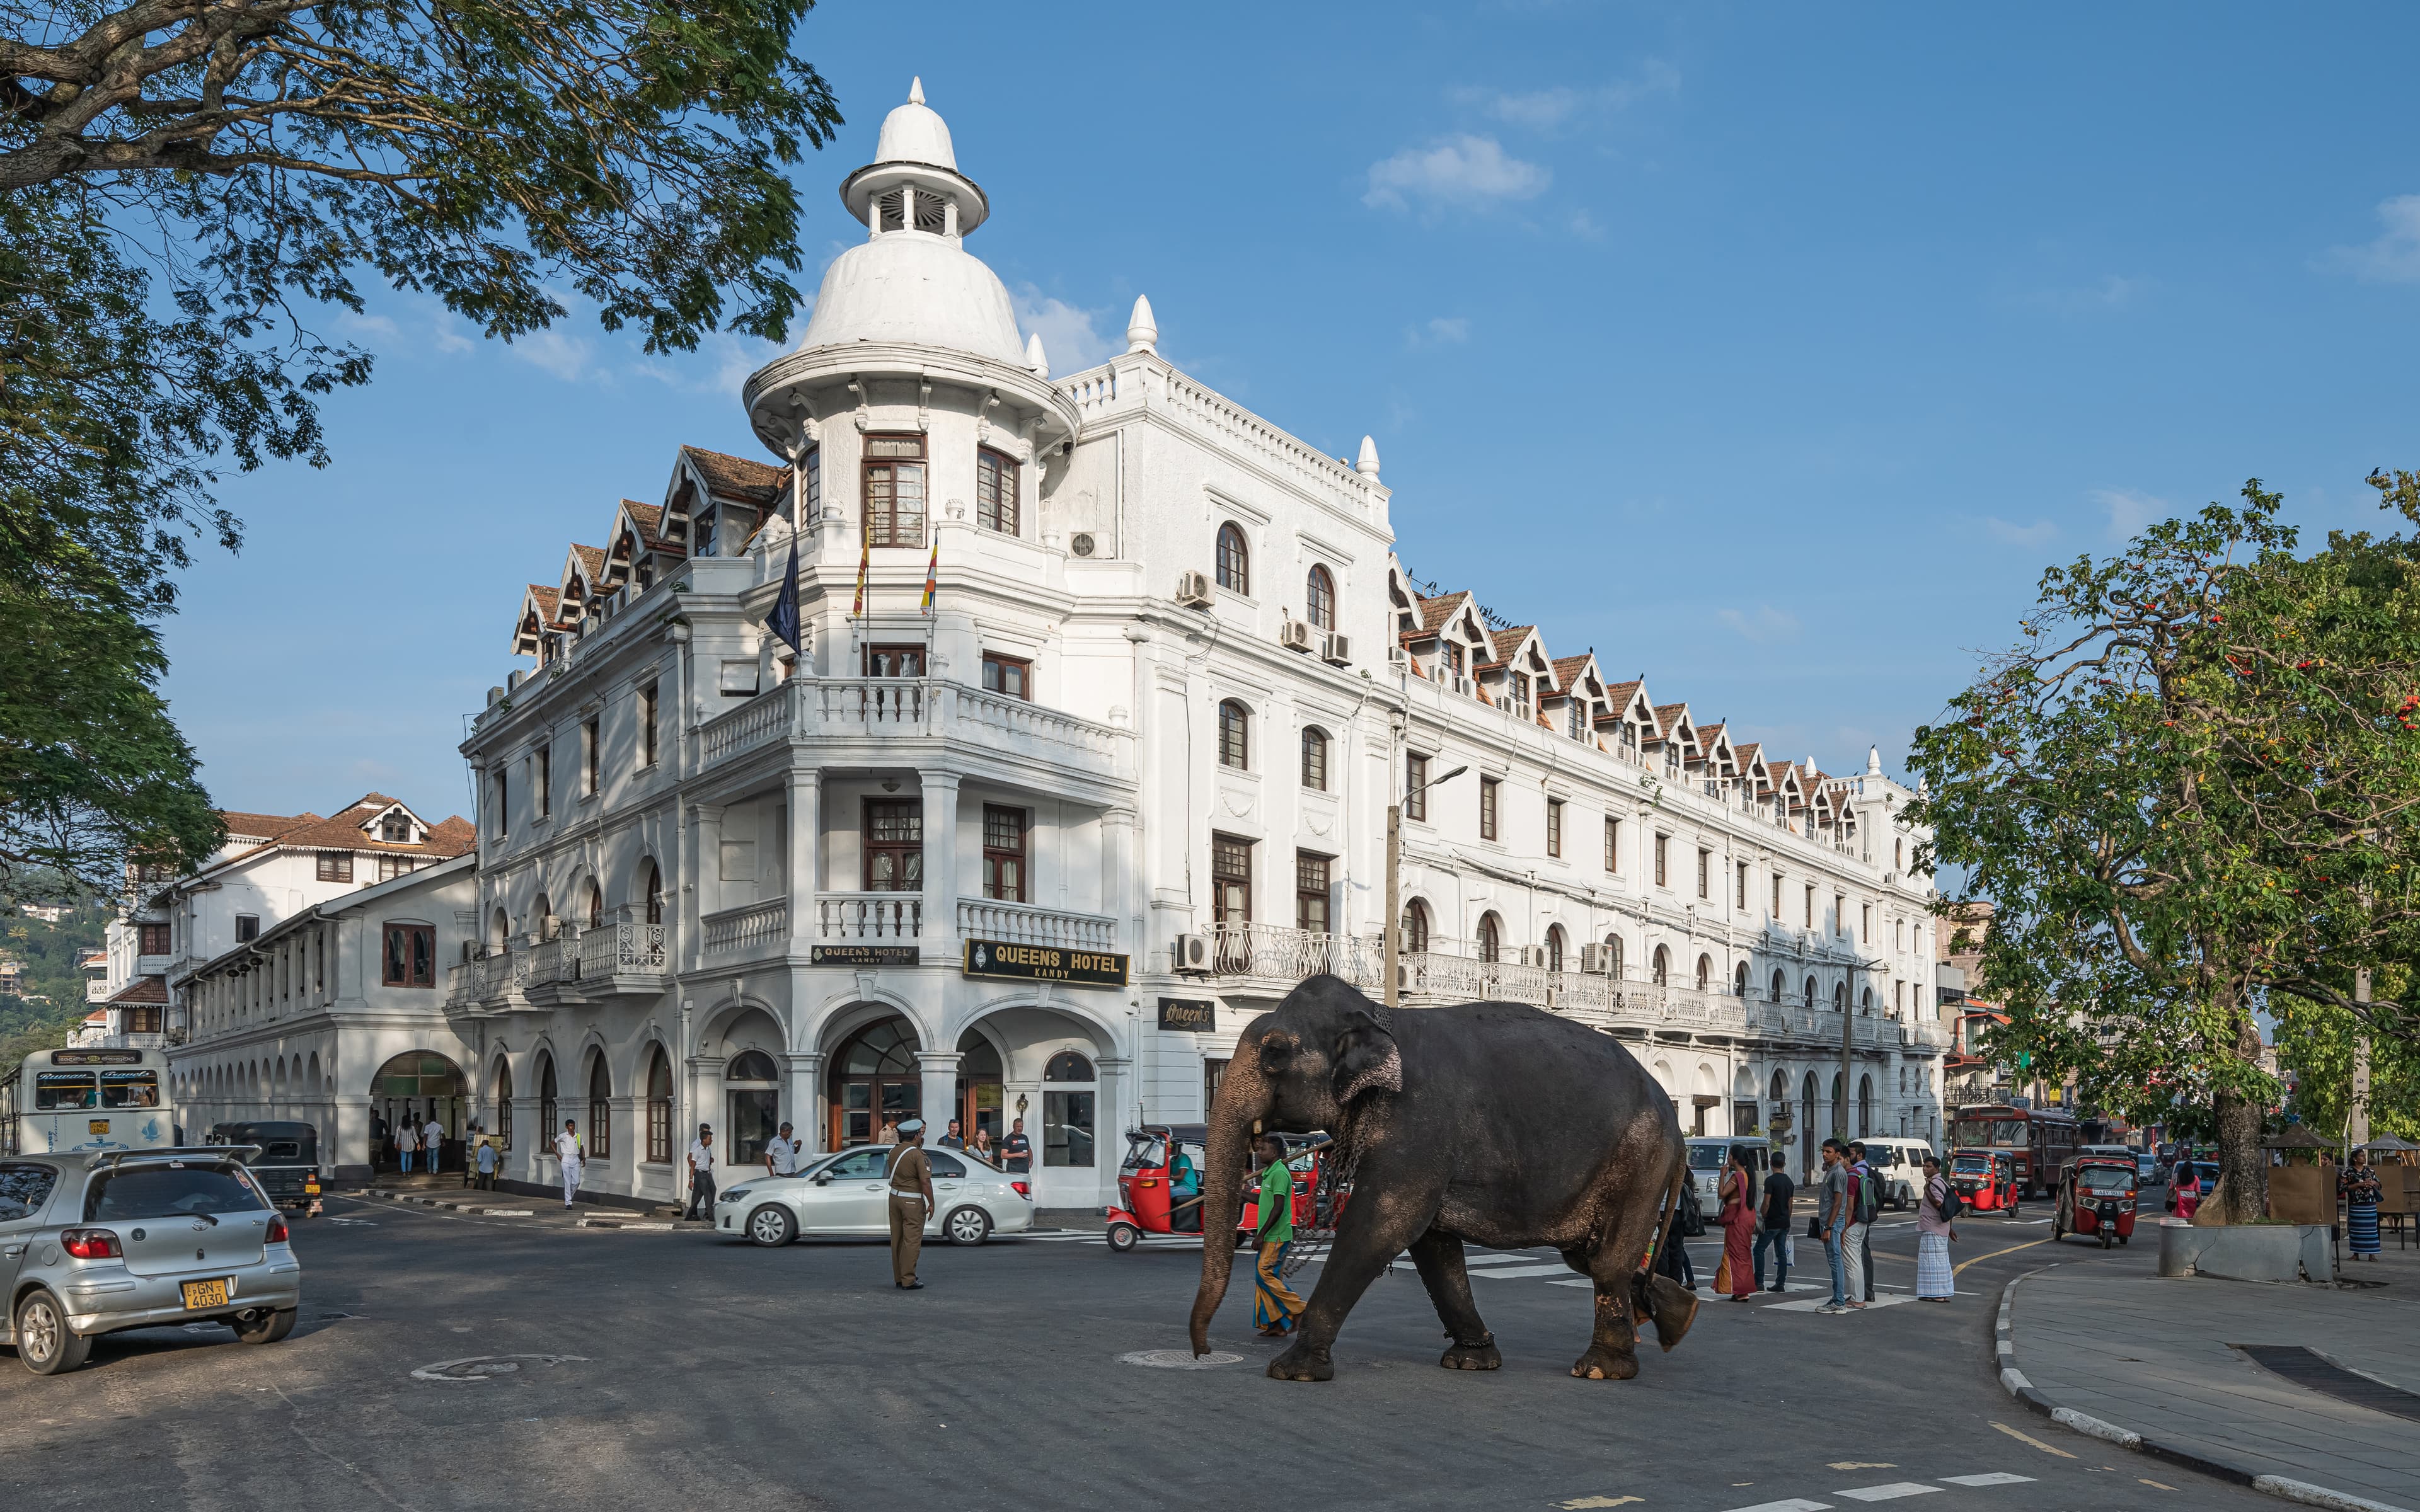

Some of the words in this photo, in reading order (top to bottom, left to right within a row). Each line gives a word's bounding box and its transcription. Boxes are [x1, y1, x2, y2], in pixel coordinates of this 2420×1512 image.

[825, 947, 870, 956] QUEEN'S
[875, 948, 909, 956] HOTEL
[996, 946, 1060, 967] QUEEN'S
[1071, 954, 1120, 972] HOTEL
[1035, 968, 1069, 978] KANDY
[1165, 1004, 1209, 1027] Queen's
[197, 1283, 214, 1295] GN
[193, 1293, 223, 1307] 4030
